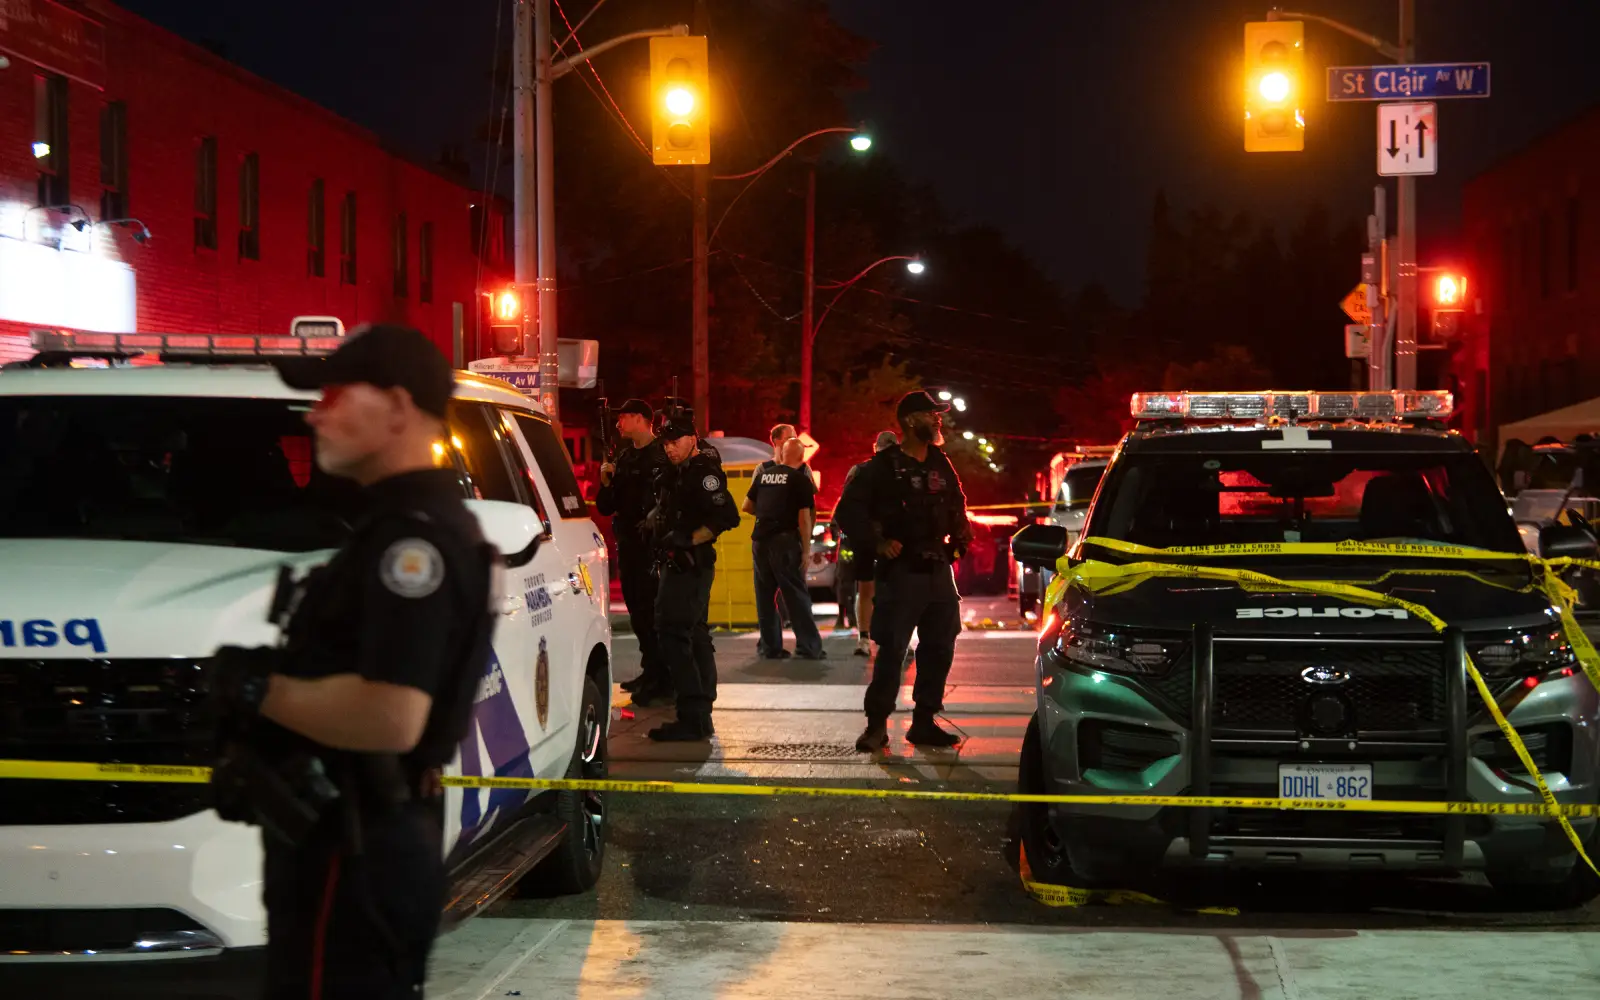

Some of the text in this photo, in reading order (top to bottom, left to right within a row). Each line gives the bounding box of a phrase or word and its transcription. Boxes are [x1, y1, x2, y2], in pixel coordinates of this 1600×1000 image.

[1342, 69, 1474, 94] St Clair Av W
[515, 376, 526, 386] Av
[527, 374, 536, 386] W
[761, 473, 788, 484] POLICE
[1283, 776, 1369, 798] DDHL 862
[1447, 803, 1507, 814] POLICE
